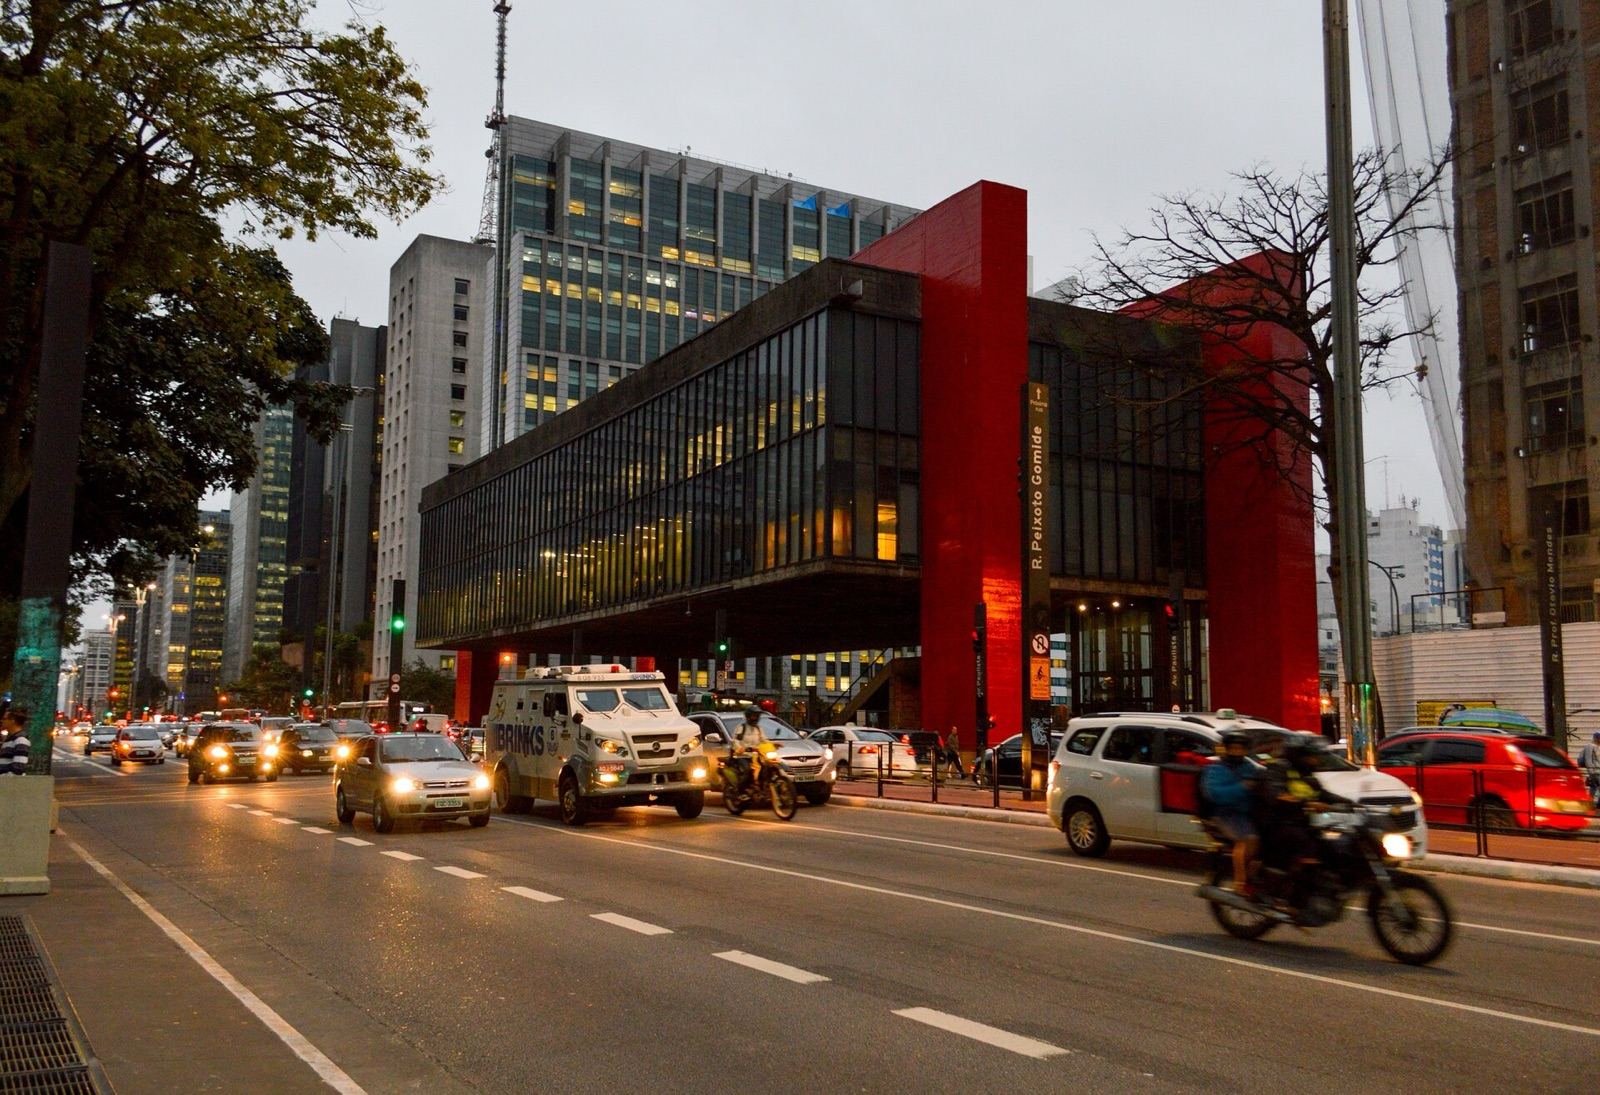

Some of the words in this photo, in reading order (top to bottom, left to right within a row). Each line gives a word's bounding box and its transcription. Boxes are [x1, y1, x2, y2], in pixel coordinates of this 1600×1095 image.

[1031, 426, 1042, 486] Gomide
[1031, 491, 1042, 552] Peixoto
[1031, 555, 1042, 570] R.
[1545, 527, 1554, 573] Mendes
[495, 723, 544, 756] BRINKS
